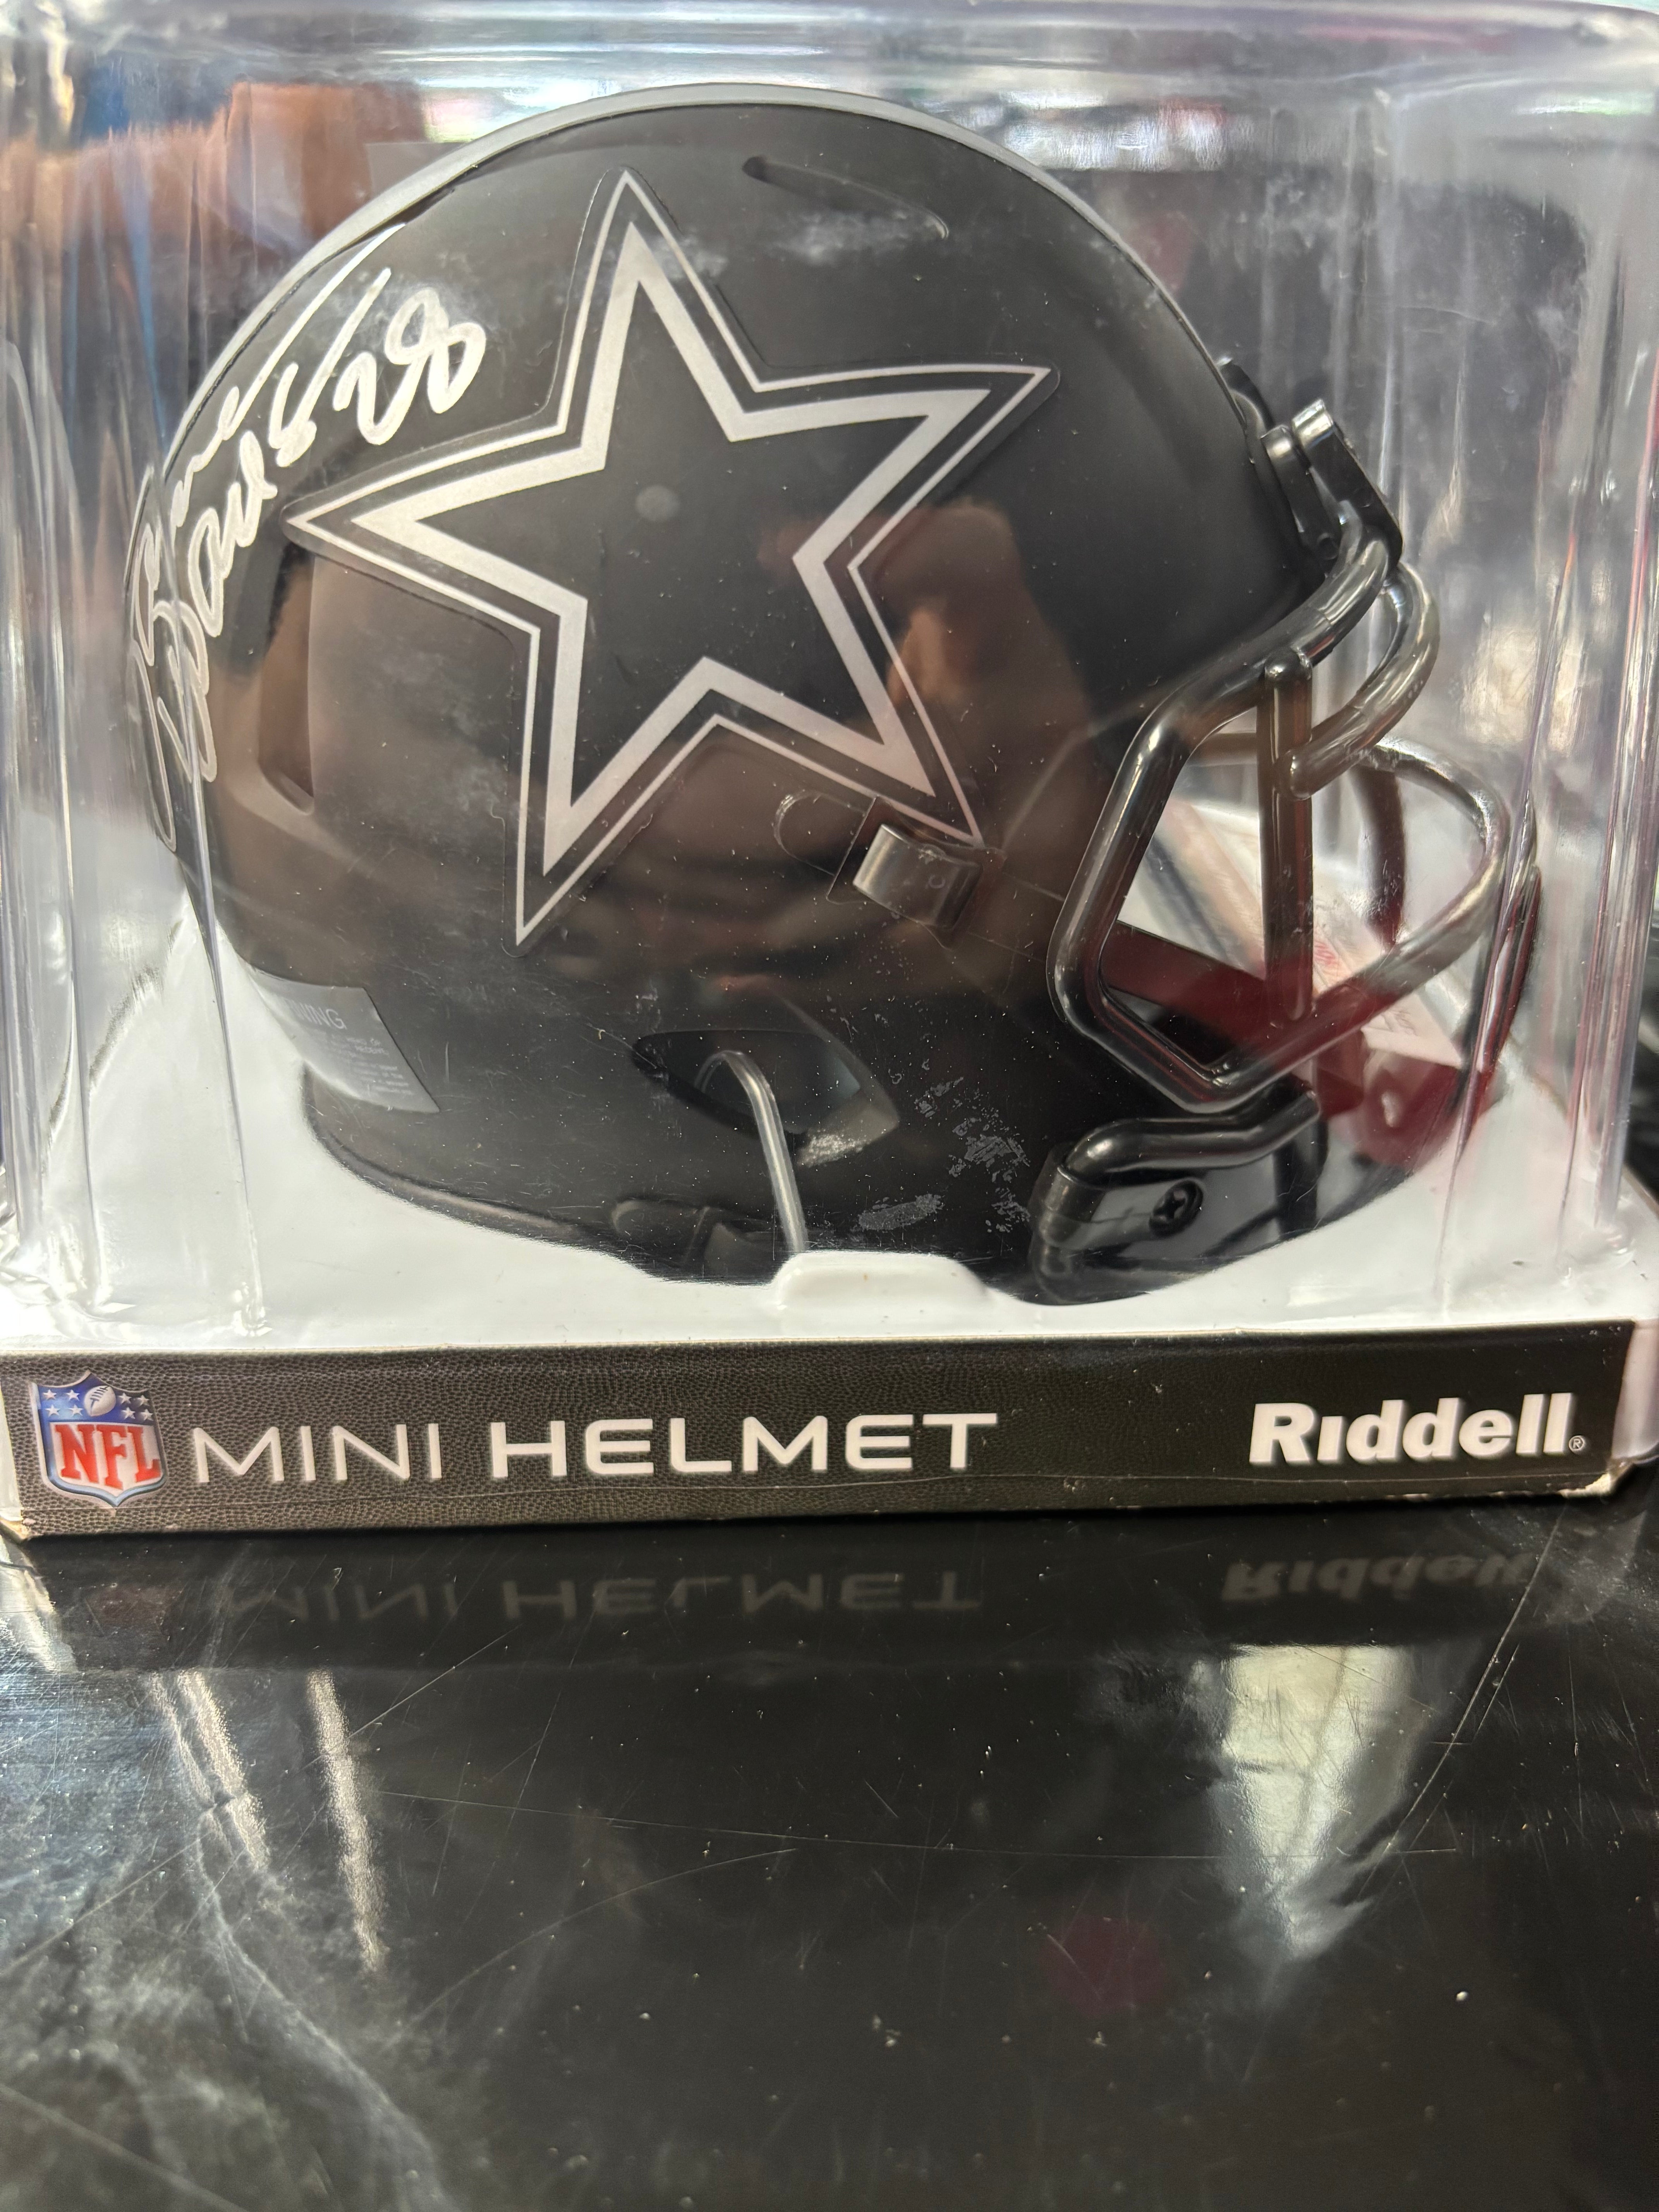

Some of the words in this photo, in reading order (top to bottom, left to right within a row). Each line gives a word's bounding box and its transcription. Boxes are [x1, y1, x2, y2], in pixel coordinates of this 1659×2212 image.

[53, 1424, 163, 1490] NFL
[191, 1424, 441, 1484] MINI
[491, 1413, 996, 1478] HELMET
